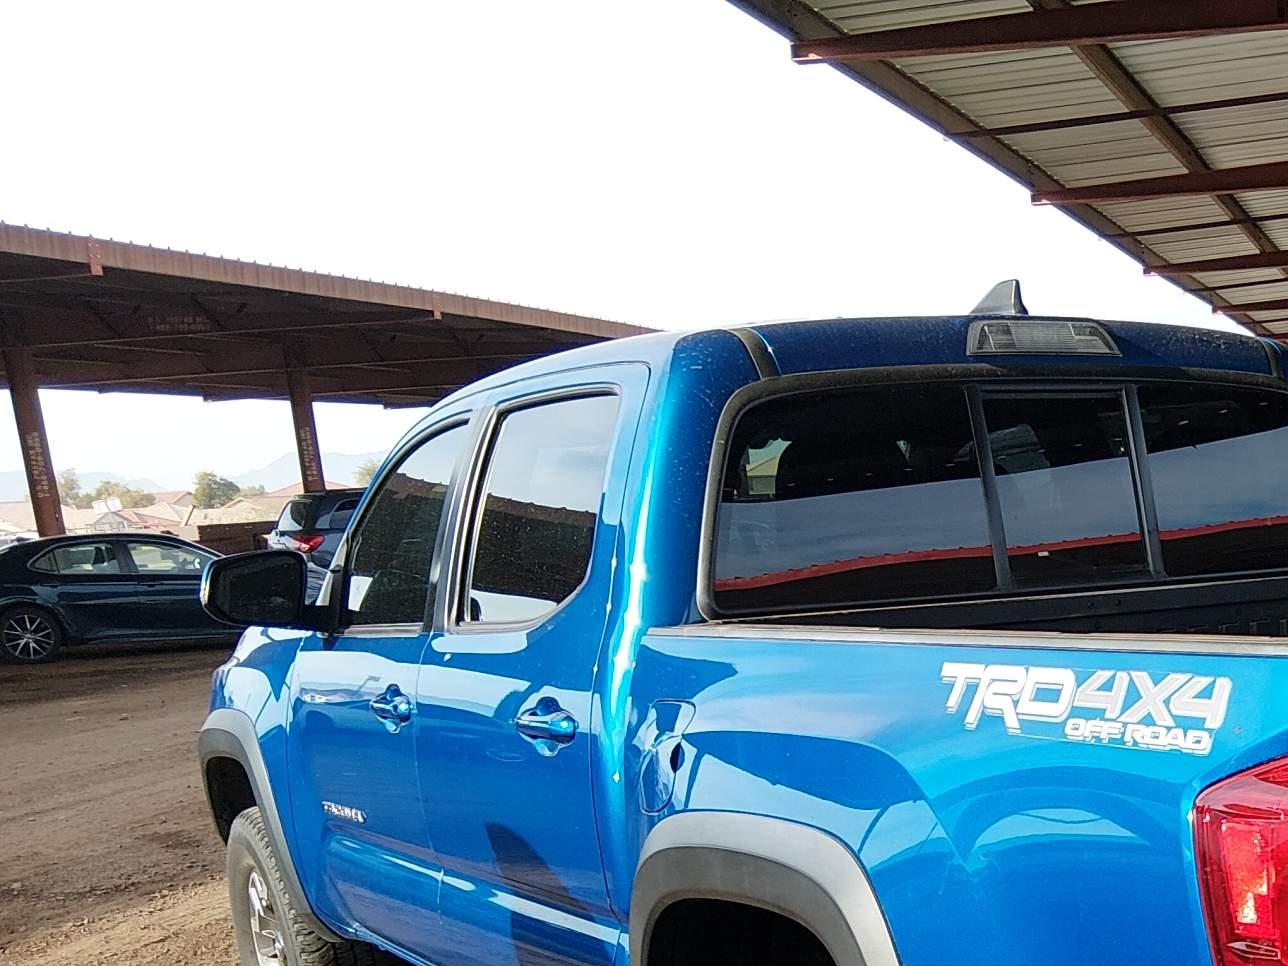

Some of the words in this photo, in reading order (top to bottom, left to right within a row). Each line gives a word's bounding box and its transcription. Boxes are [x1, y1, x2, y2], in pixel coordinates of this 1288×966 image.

[940, 662, 1077, 735] TRD
[1073, 669, 1232, 730] 4X4
[1064, 717, 1124, 743] OFF
[1124, 724, 1212, 757] ROAD
